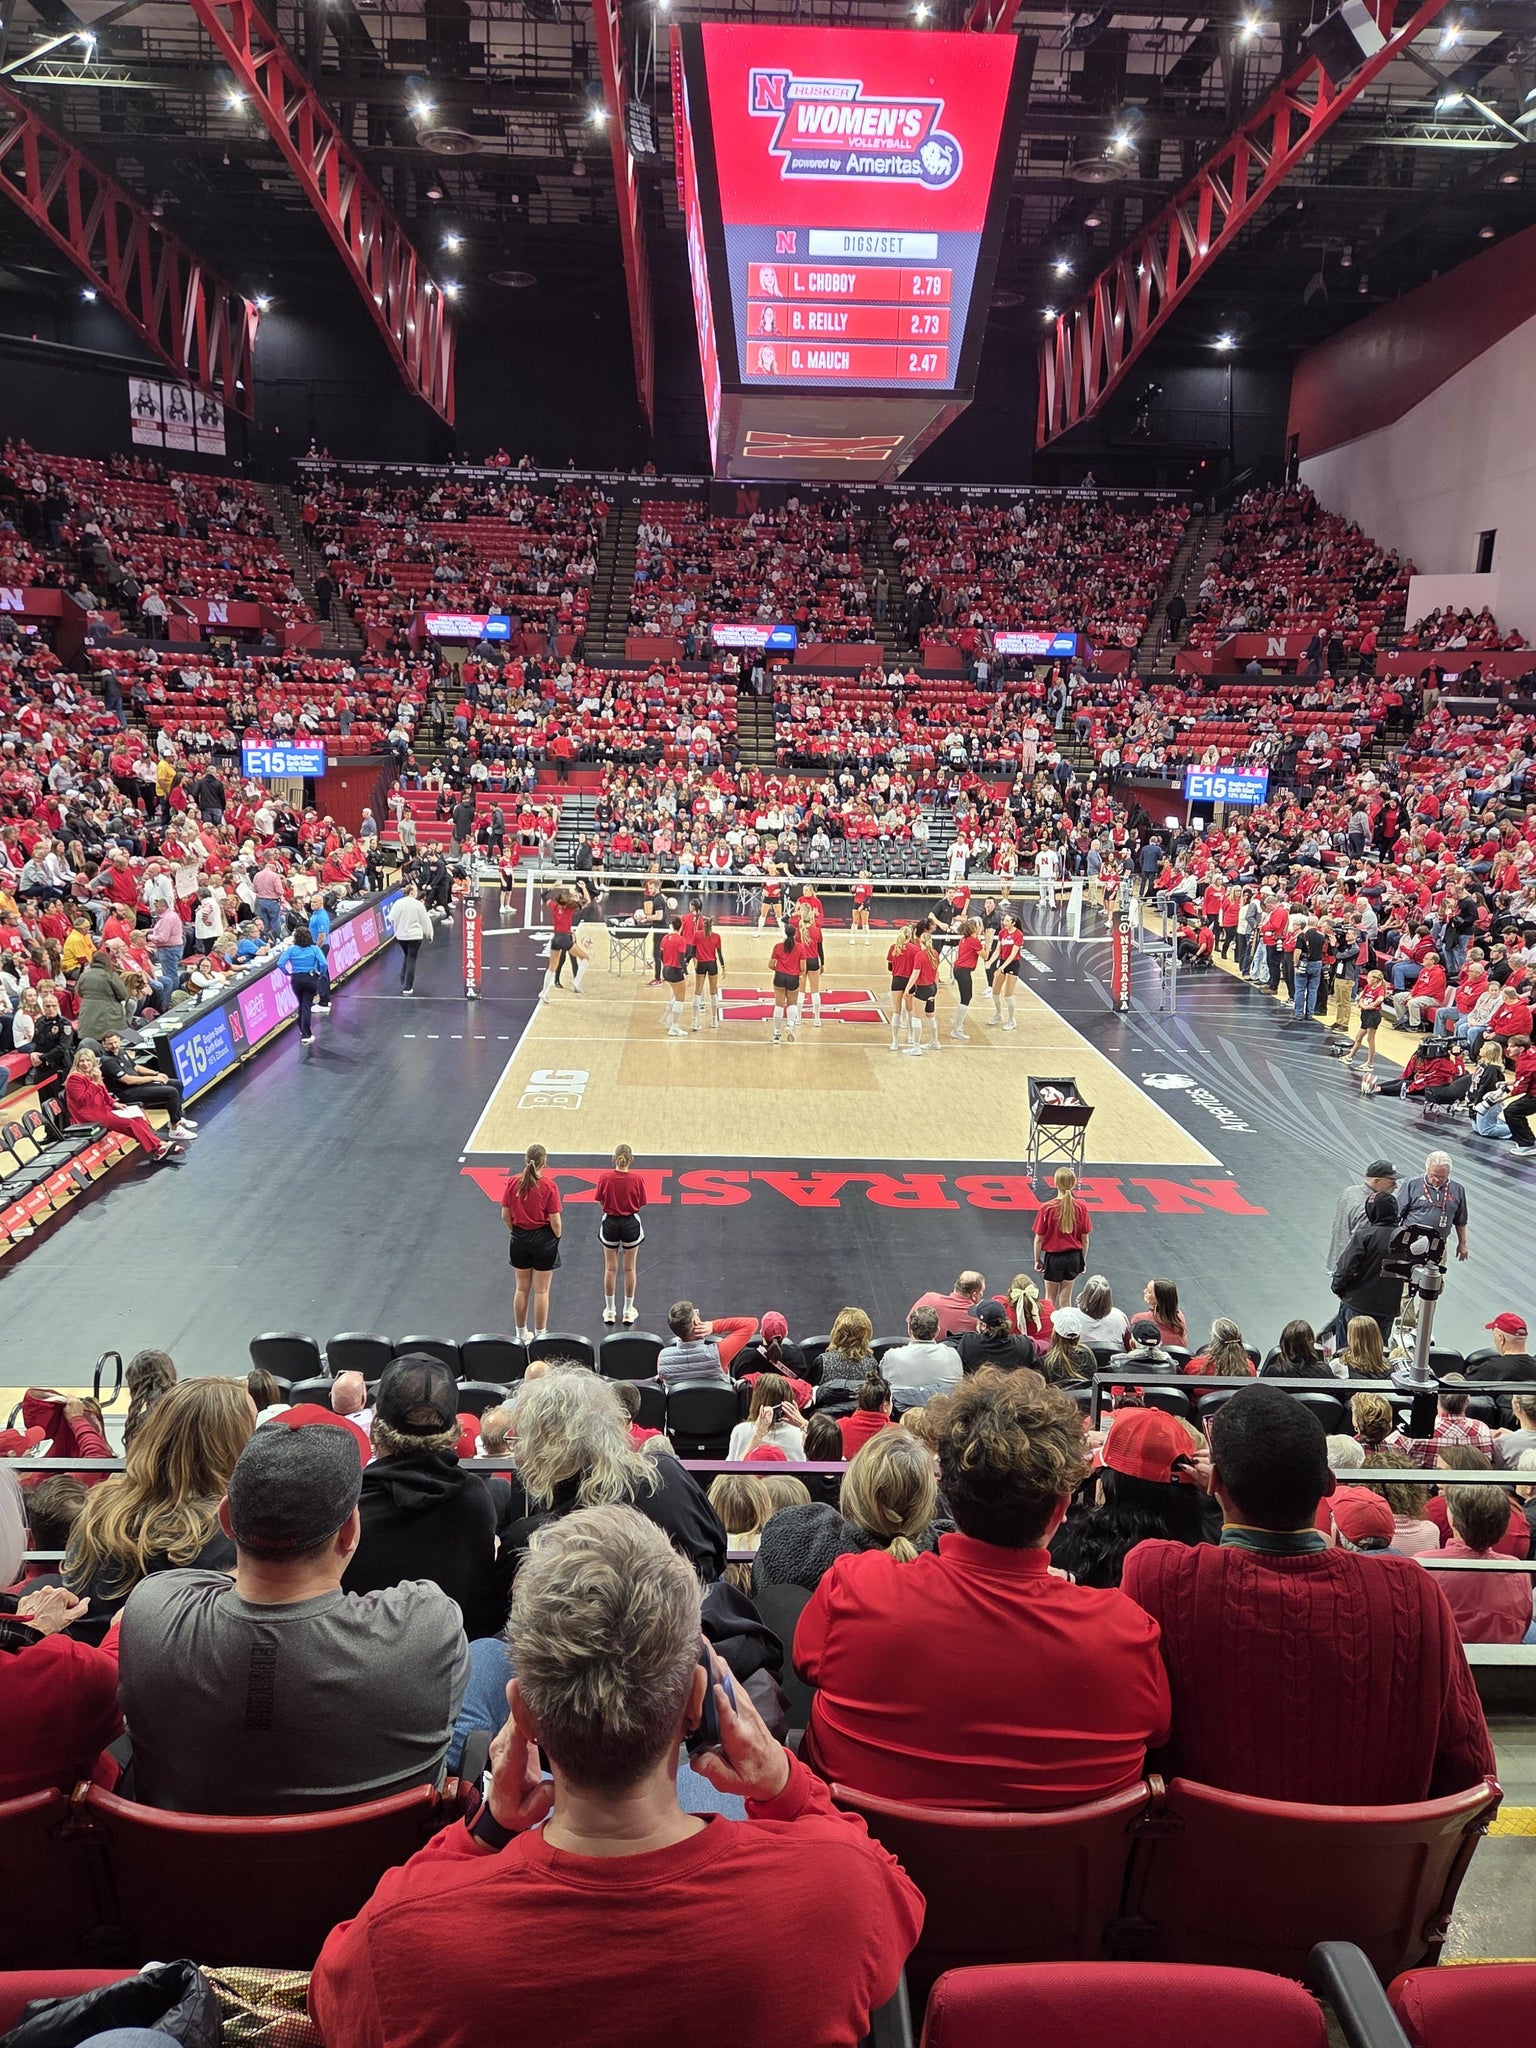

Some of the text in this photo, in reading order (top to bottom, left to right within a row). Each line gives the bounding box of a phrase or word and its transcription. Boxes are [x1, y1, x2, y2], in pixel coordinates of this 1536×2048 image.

[755, 74, 785, 111] N
[793, 85, 850, 98] HUSKER
[797, 104, 923, 137] WOMEN'S
[847, 136, 913, 150] VOLLEYBALL
[791, 153, 922, 176] powered by Ameritas
[775, 230, 797, 254] N
[843, 235, 904, 254] DIGS/SET
[793, 272, 805, 291] L.
[808, 272, 856, 293] CHOBOY
[793, 312, 940, 334] B. REILLY 2.73
[791, 350, 938, 373] O. MAUCH 2.47
[0, 588, 25, 611] N
[207, 602, 228, 623] N
[1266, 637, 1287, 656] N
[247, 751, 286, 773] E15
[1189, 776, 1227, 798] E15
[956, 850, 963, 858] N
[1041, 857, 1048, 865] N
[466, 920, 476, 997] NEBRASKA
[1120, 935, 1130, 1010] NEBRASKA
[228, 1010, 244, 1042] N
[175, 1034, 207, 1087] E15
[1185, 1088, 1258, 1134] Ameritas
